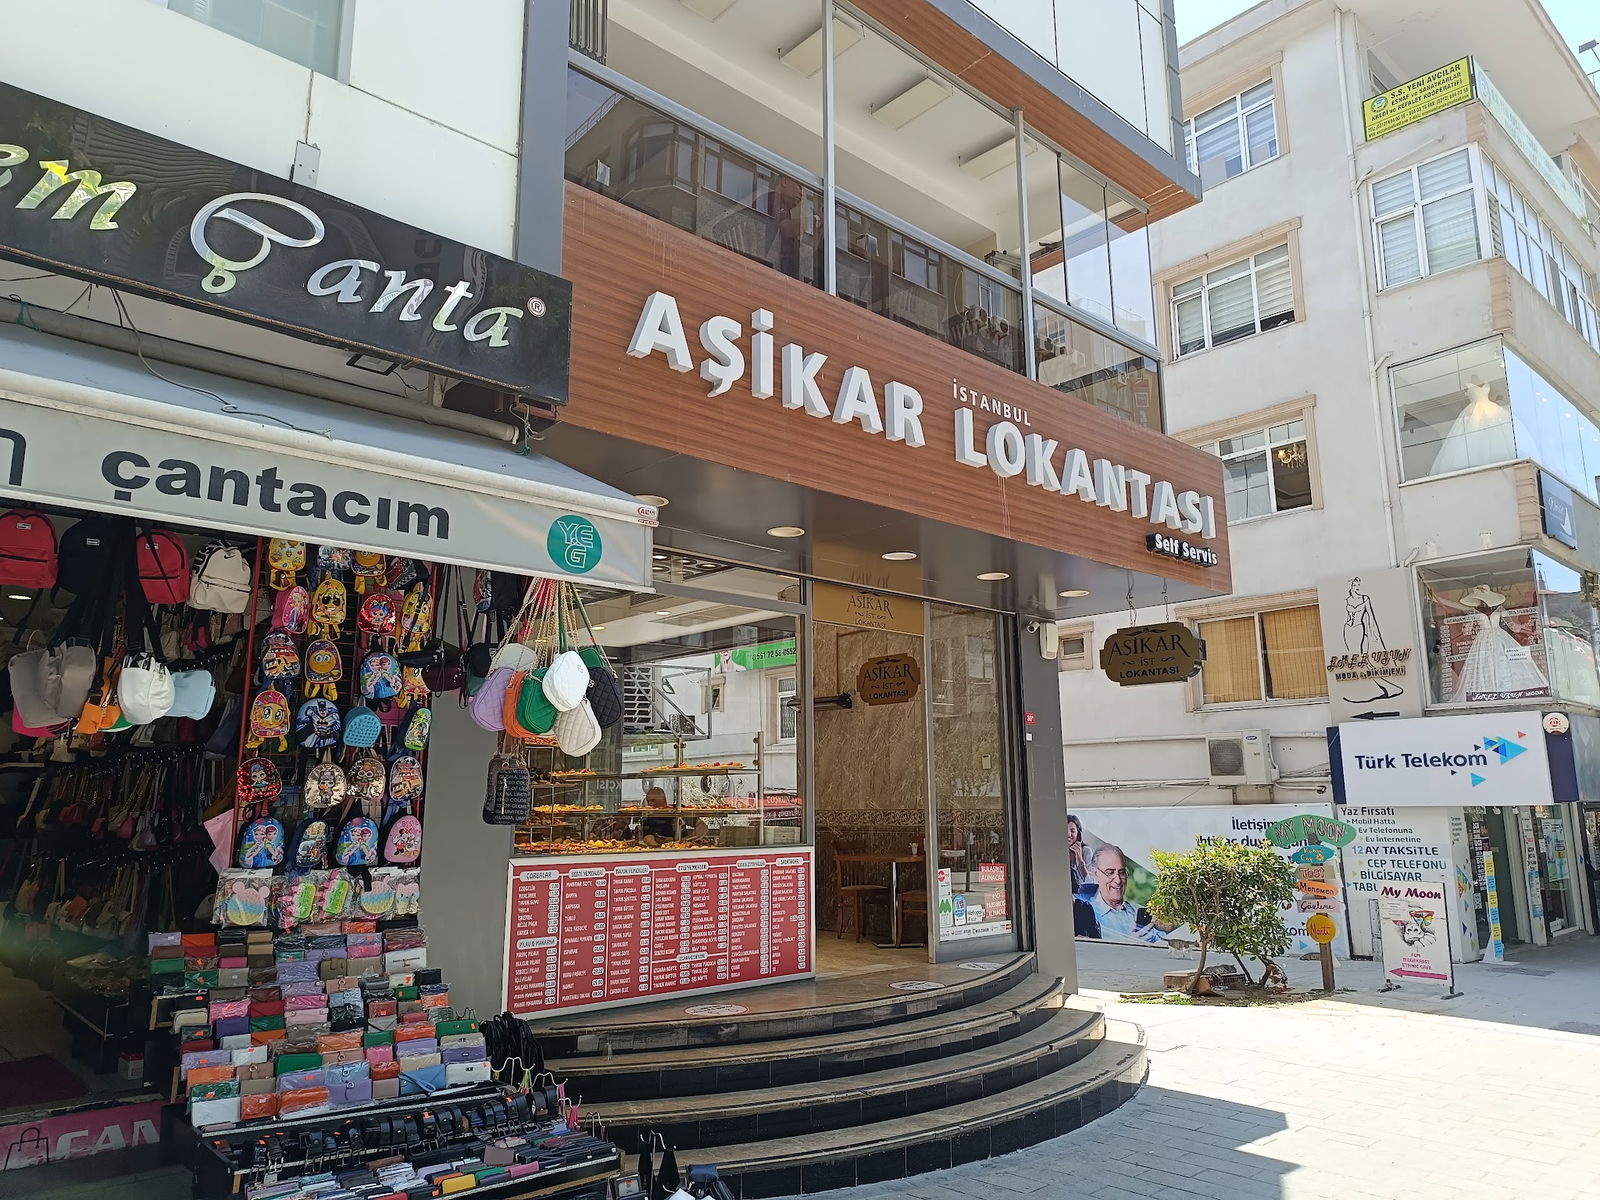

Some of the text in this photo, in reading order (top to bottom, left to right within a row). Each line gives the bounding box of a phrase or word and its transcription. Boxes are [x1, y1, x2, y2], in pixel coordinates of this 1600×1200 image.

[1407, 78, 1425, 91] YENİ
[1427, 64, 1461, 84] AVCILAR
[190, 192, 526, 349] Çanta
[626, 290, 926, 448] AŞİKAR
[951, 378, 1033, 428] İSTANBUL
[953, 406, 1216, 539] LOKANTASI
[100, 450, 451, 541] çantacım
[1153, 533, 1219, 568] Self Servis
[1119, 666, 1180, 679] LOKANTASI
[1336, 671, 1359, 681] MODA
[868, 689, 909, 700] LOKANTASI
[1354, 751, 1488, 770] Türk Telekom
[1340, 807, 1395, 816] Yaz Fırsatı
[1273, 816, 1346, 843] MY MOON
[1369, 827, 1414, 835] Telefonuna
[1351, 846, 1364, 855] 12
[1364, 846, 1380, 855] AY
[1367, 859, 1447, 870] CEP TELEFONU
[1360, 869, 1423, 882] BİLGİSAYAR
[1380, 887, 1442, 900] My Moon
